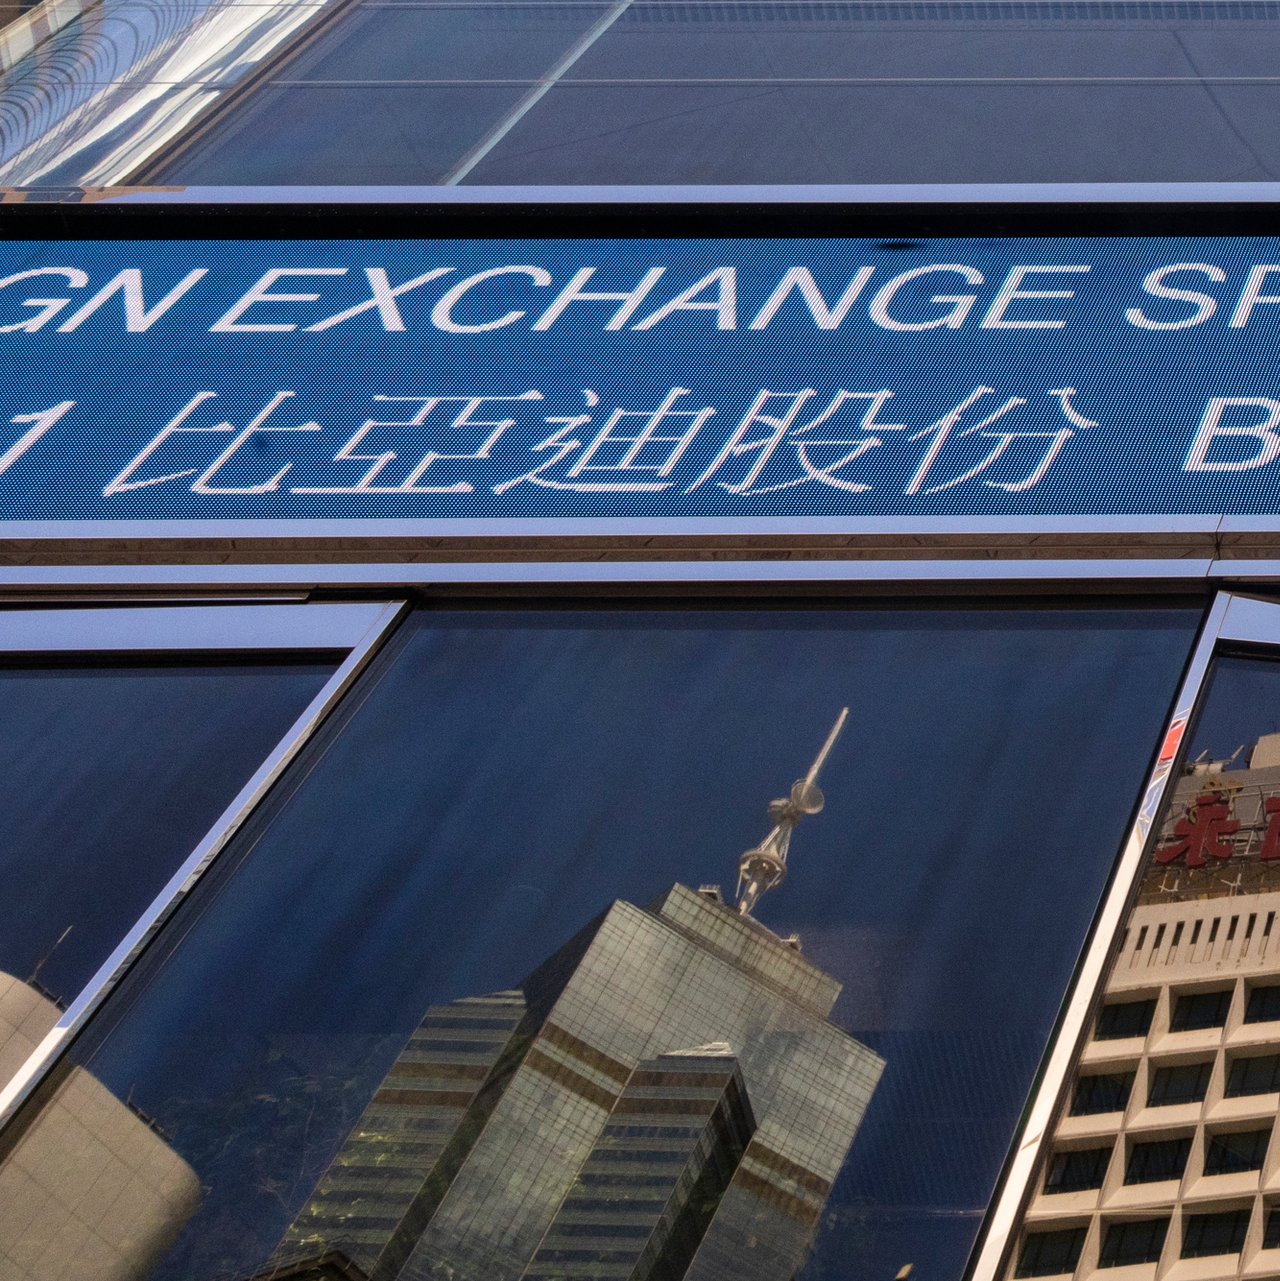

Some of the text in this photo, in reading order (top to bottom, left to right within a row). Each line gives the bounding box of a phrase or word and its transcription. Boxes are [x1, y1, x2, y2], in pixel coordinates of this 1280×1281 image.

[208, 263, 1091, 335] EXCHANGE
[102, 385, 1098, 498] 比亞迪股份
